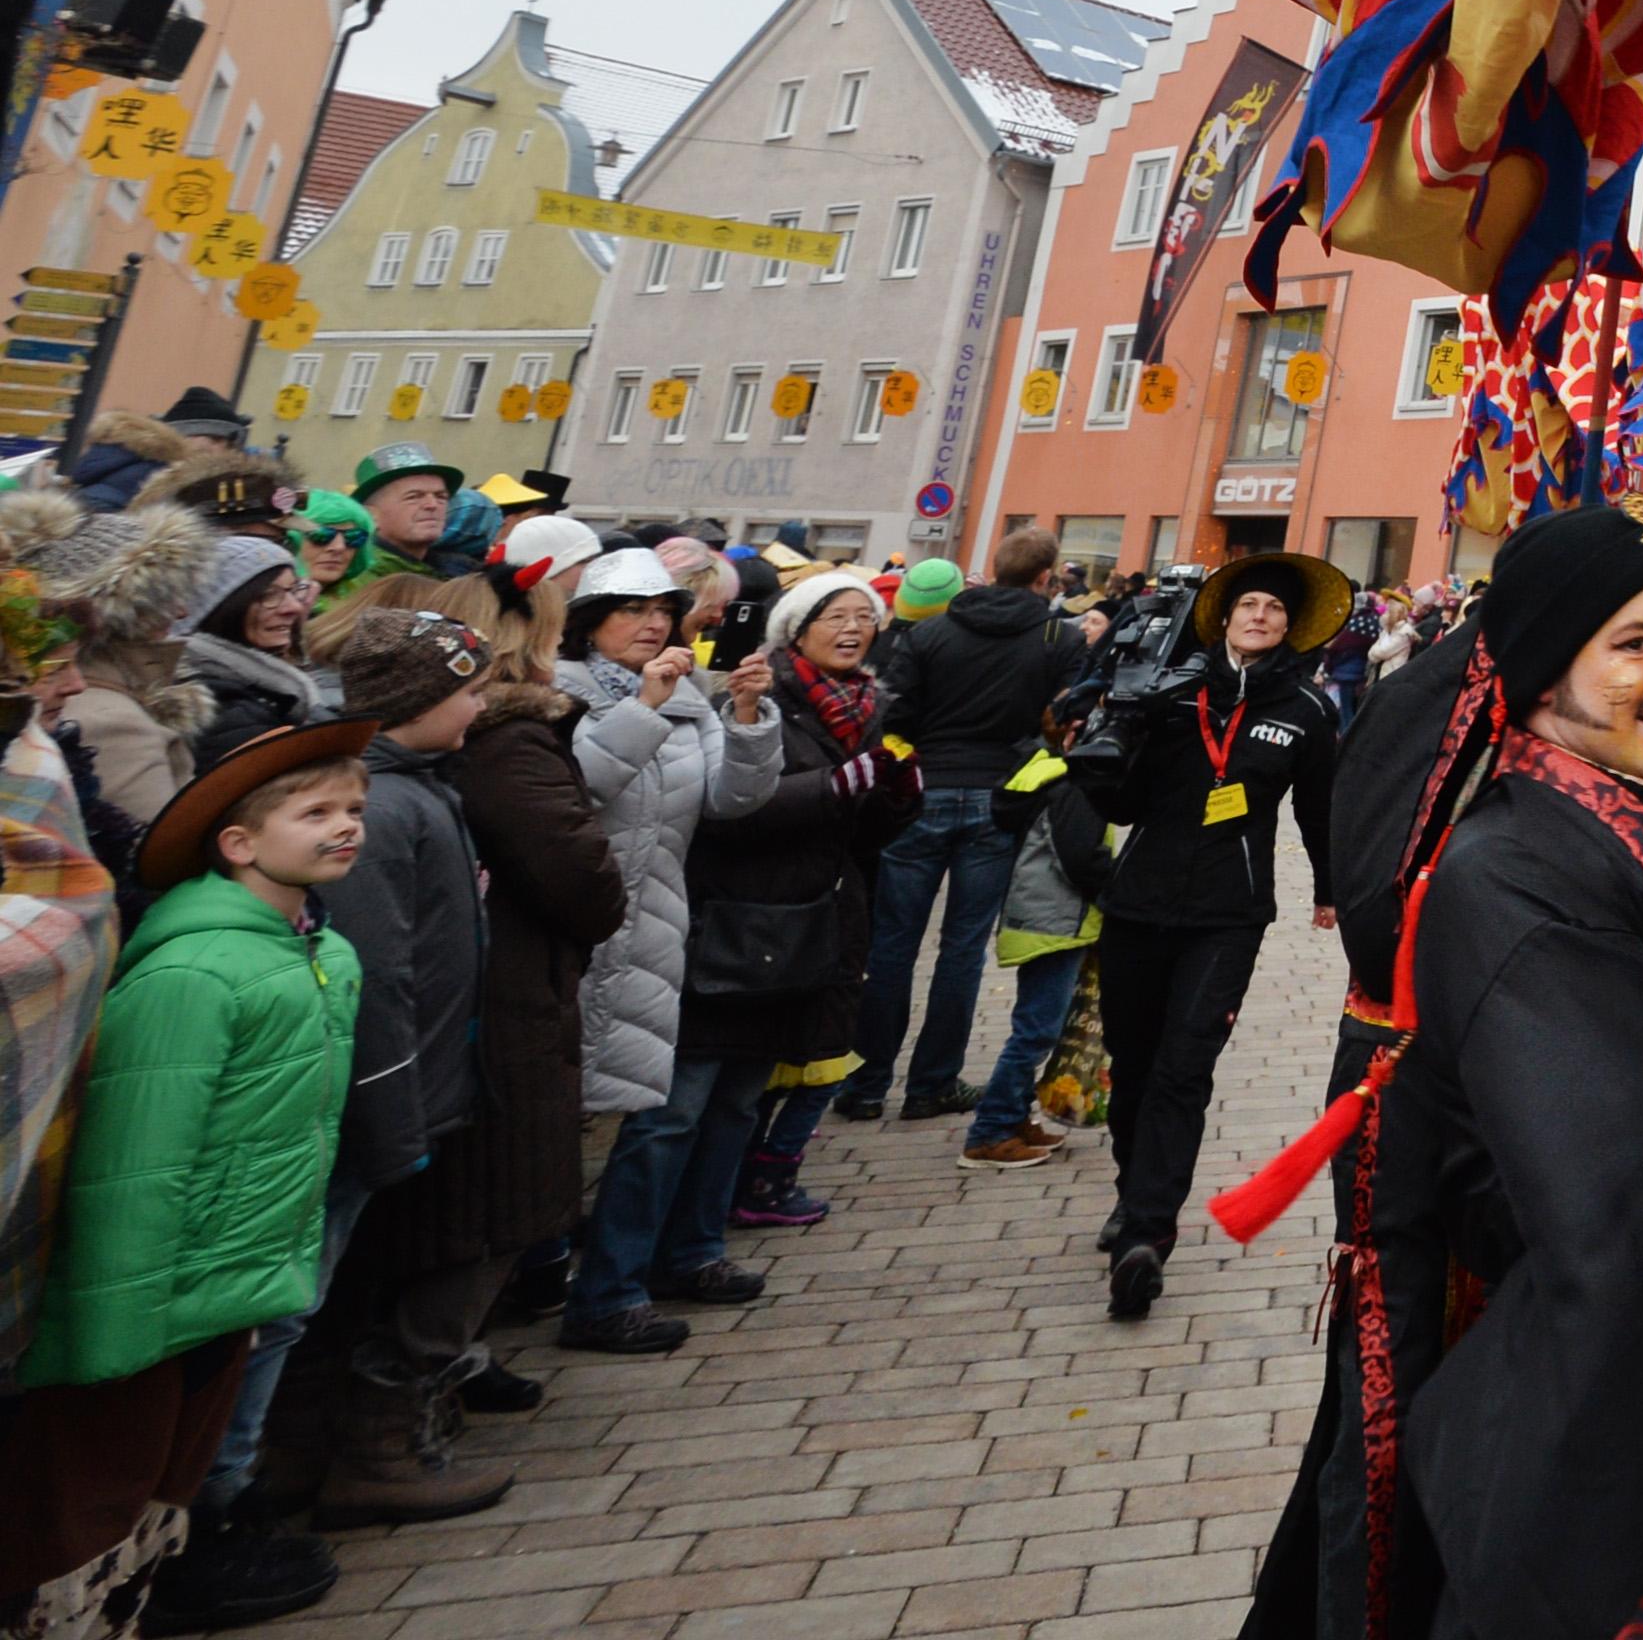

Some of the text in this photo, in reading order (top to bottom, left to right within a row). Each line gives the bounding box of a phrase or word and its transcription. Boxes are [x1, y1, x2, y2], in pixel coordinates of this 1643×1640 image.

[933, 232, 1000, 481] UHREN SCHMUCK
[1214, 475, 1297, 503] GÖTZ
